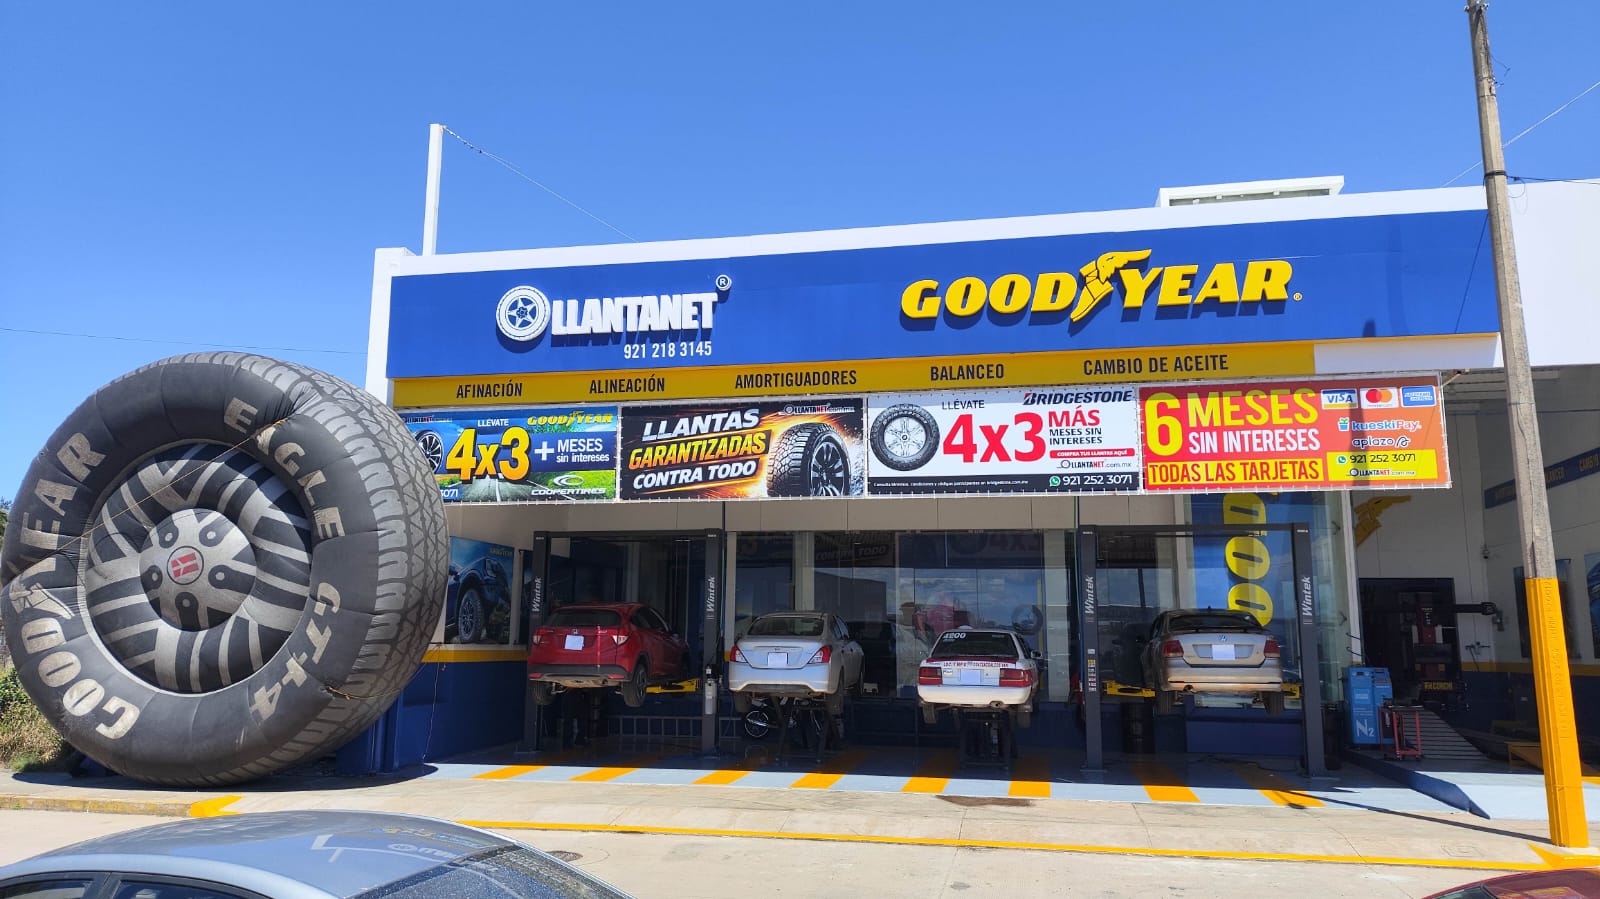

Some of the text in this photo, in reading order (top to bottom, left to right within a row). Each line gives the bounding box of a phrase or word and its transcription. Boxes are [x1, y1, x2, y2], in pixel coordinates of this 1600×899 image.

[901, 252, 1293, 320] GOODYEAR
[551, 292, 718, 335] LLANTANET
[624, 340, 712, 359] 921 218 3145
[930, 363, 1005, 381] BALANCEO
[1083, 354, 1228, 376] CAMBIO DE ACEITE
[589, 375, 665, 394] ALINEACIÓN
[735, 370, 857, 389] AMORTIGUADORES
[456, 381, 523, 399] AFINACIÓN
[1023, 390, 1133, 405] BRIDGESTONE
[1328, 393, 1353, 404] VISA
[942, 399, 985, 410] LLÉVATE
[527, 411, 613, 426] GOODYEAR
[642, 408, 760, 442] LLANTAS
[1048, 405, 1100, 427] MÁS
[1145, 388, 1318, 456] 6 MESES
[942, 412, 1046, 463] 4x3
[1049, 427, 1102, 436] MESES SIN
[1049, 436, 1102, 445] INTERESES
[1188, 428, 1320, 454] SIN INTERESES
[557, 438, 603, 453] MESES
[629, 432, 767, 470] GARANTIZADAS
[1352, 437, 1394, 448] aplazo
[446, 426, 530, 481] 4x3
[556, 453, 610, 463] sin intereses
[1350, 453, 1416, 464] 921 252 3071
[633, 460, 757, 489] CONTRA TODO
[1063, 474, 1132, 486] 921 252 3071
[1150, 460, 1319, 483] TODAS LAS TARJETAS
[531, 576, 542, 613] Wintek
[706, 575, 716, 613] Wintek
[1085, 575, 1095, 615] Wintek
[1302, 576, 1312, 617] Wintek
